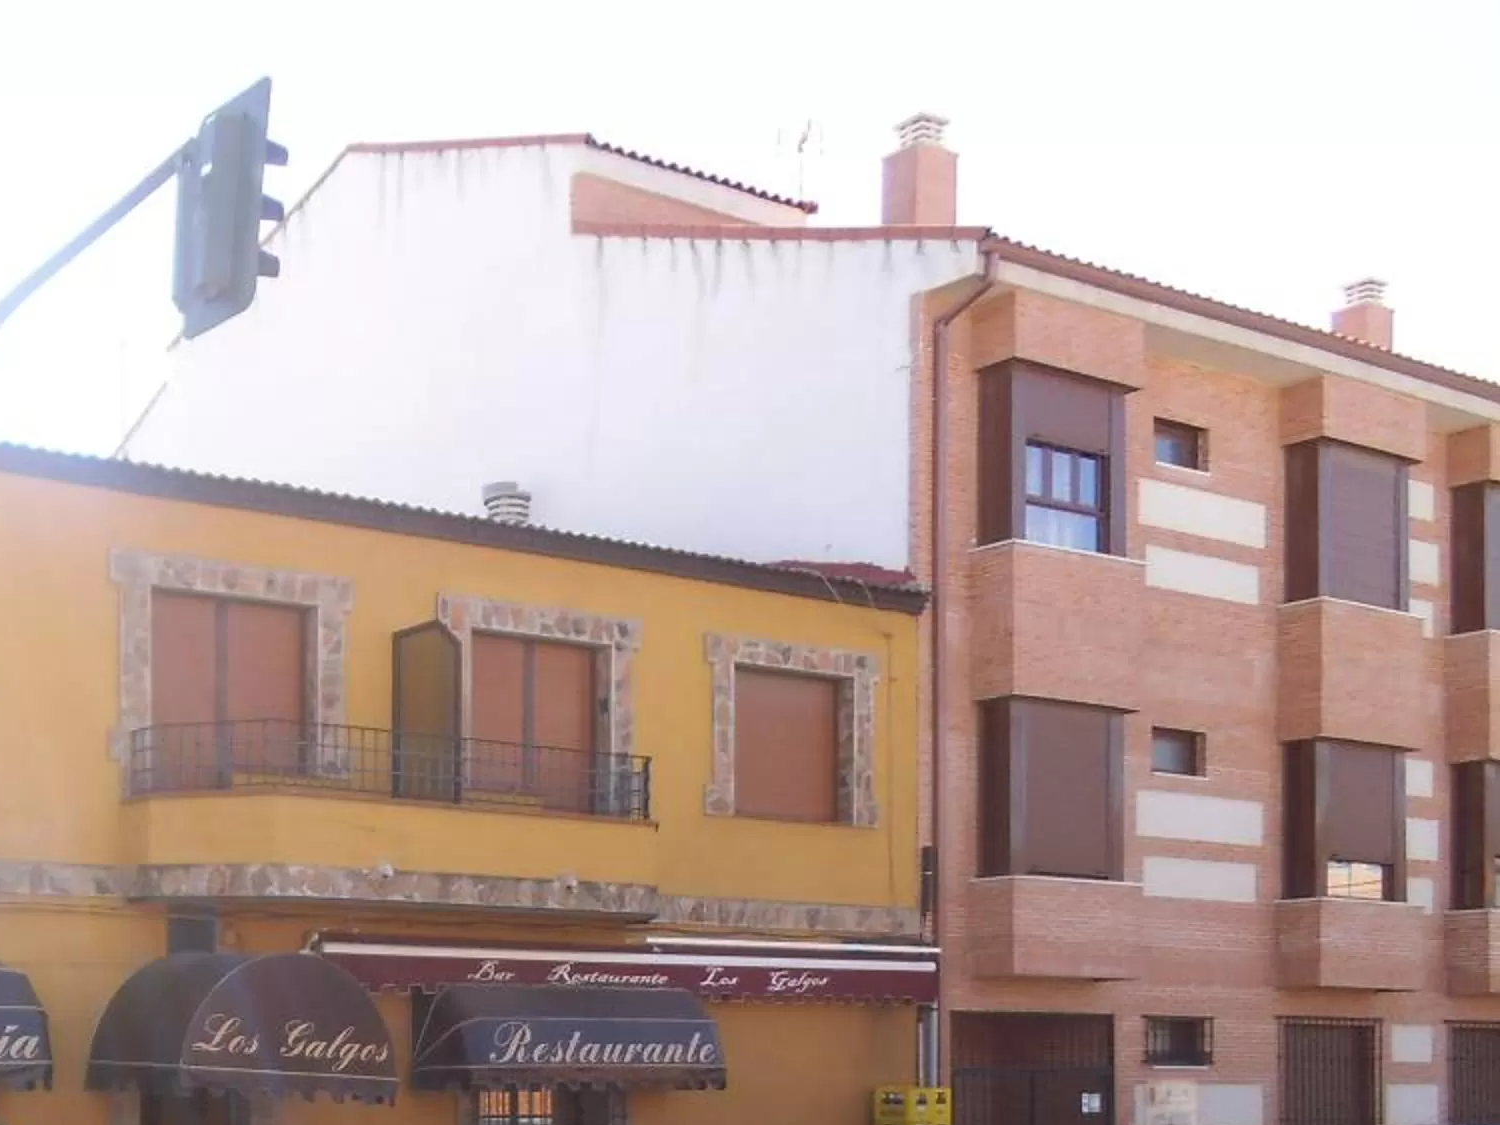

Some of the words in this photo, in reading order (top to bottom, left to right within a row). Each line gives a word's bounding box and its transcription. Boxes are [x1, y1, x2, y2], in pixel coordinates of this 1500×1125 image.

[467, 960, 515, 981] Bar
[547, 961, 669, 985] Restaurante
[699, 966, 738, 986] Los
[766, 970, 828, 993] Galgos
[191, 1013, 261, 1055] Los
[279, 1019, 390, 1073] Galgos
[488, 1020, 717, 1064] Restaurante
